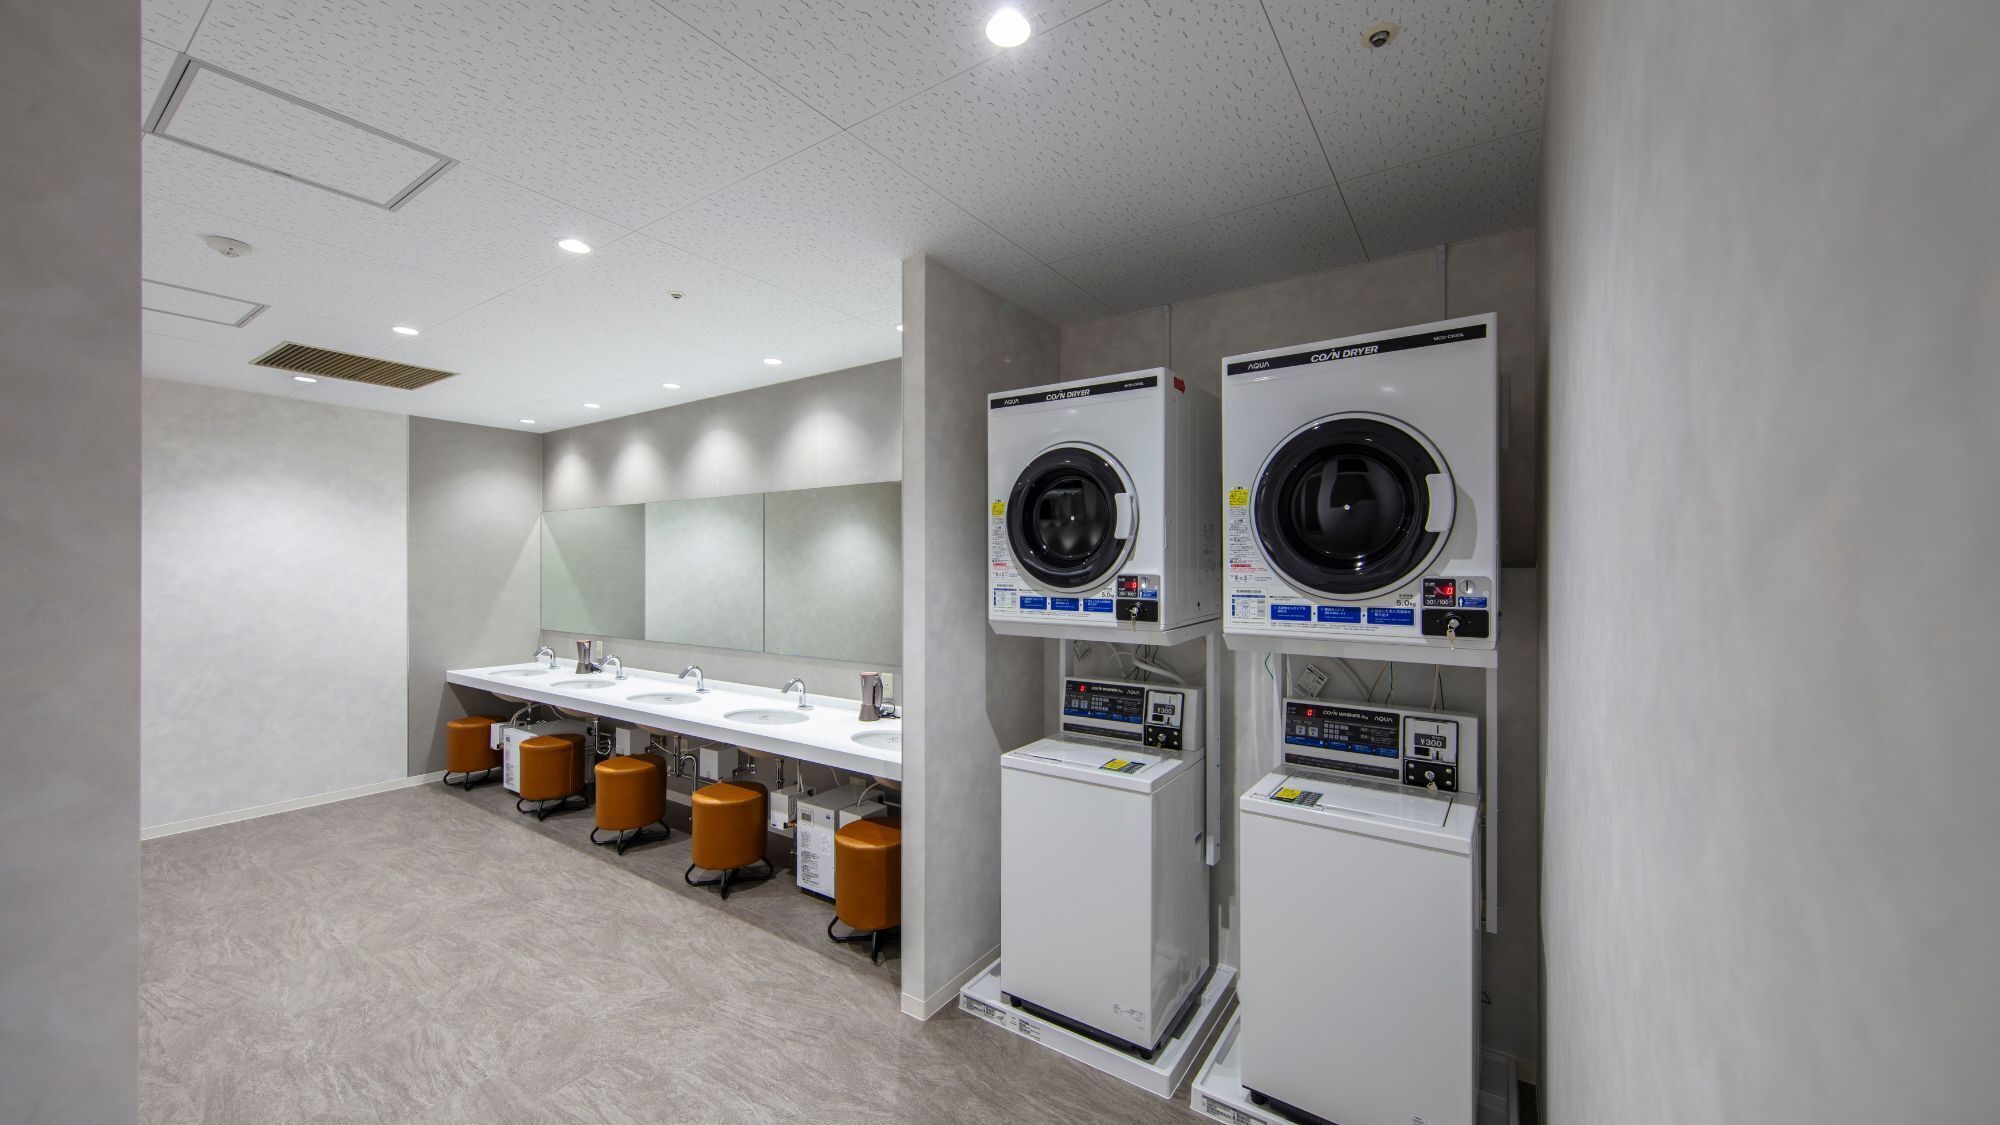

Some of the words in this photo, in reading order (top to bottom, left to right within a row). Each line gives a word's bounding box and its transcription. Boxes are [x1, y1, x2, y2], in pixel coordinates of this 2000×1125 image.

[1342, 345, 1379, 358] DRYER
[1247, 361, 1270, 371] AQUA
[1066, 388, 1090, 399] DRYER
[1004, 397, 1020, 406] AQUA
[1374, 715, 1393, 723] AQUA
[1420, 737, 1442, 748] ¥300
